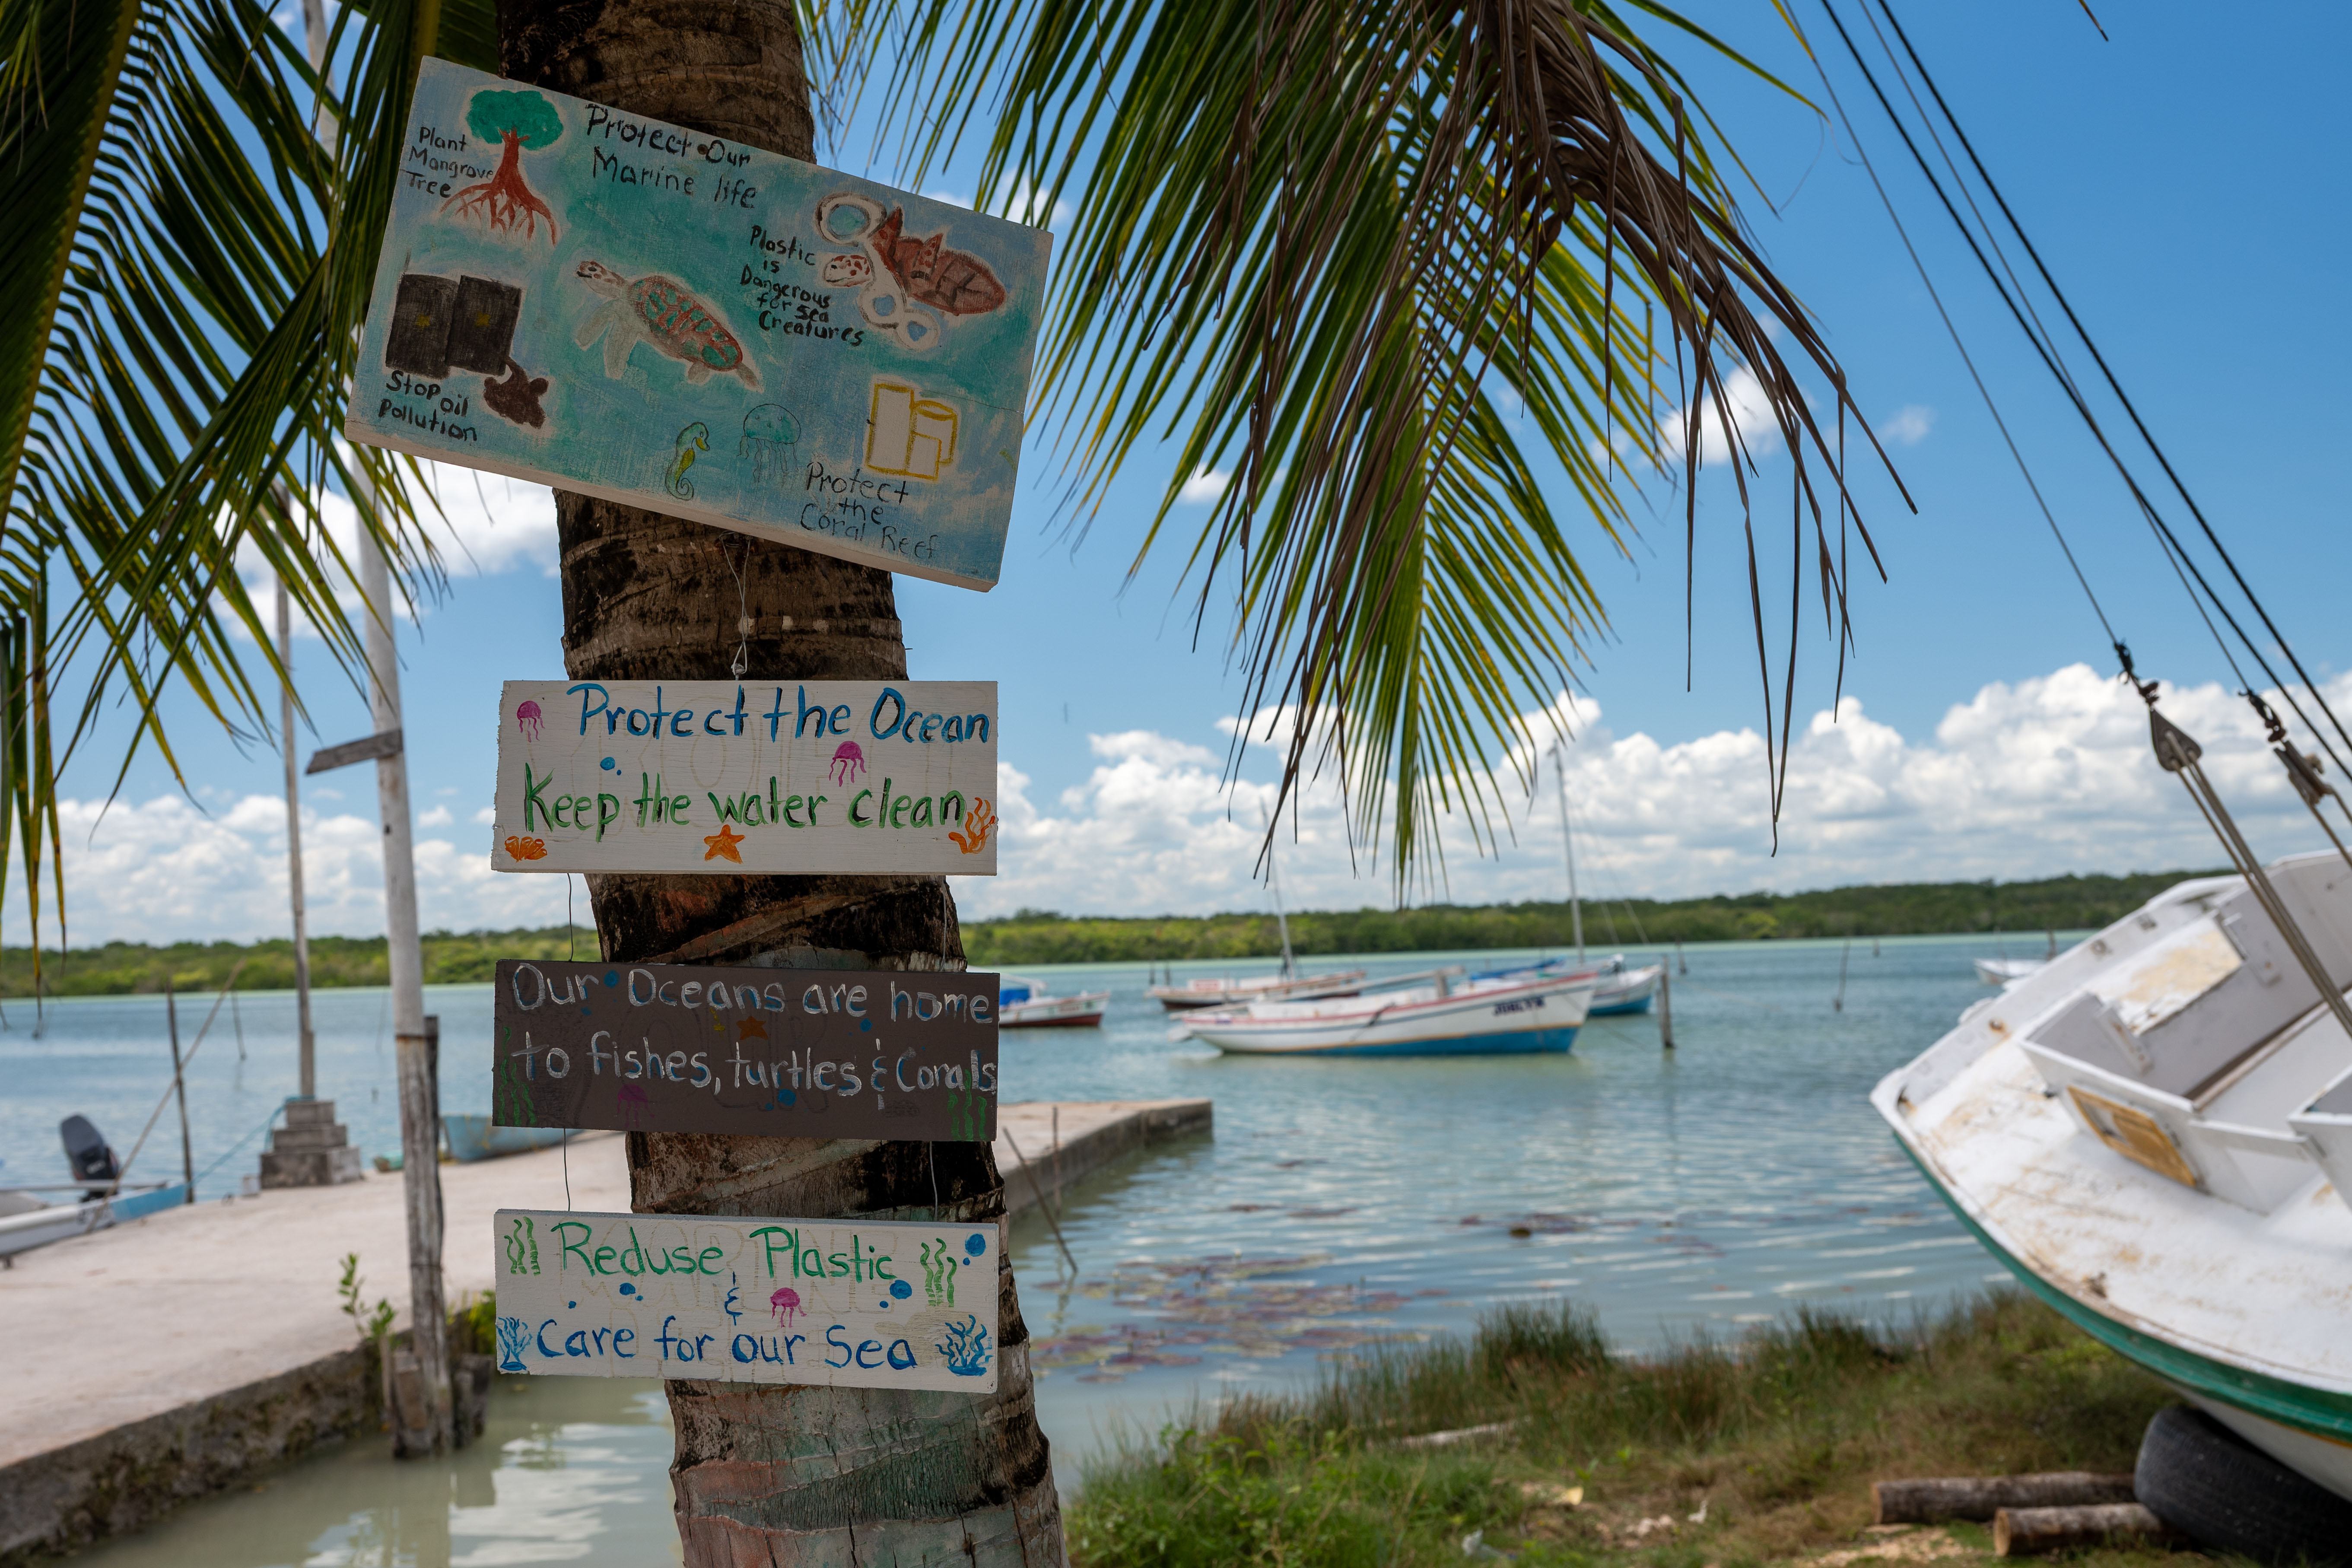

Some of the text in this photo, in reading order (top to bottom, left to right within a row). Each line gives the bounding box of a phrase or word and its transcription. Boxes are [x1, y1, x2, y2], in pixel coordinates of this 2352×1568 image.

[419, 127, 467, 152] Plant
[585, 104, 750, 168] Protect Our
[409, 146, 493, 178] Mangrove
[593, 146, 757, 208] Marine life
[406, 171, 451, 198] Tree
[750, 225, 815, 265] Plastic
[763, 256, 779, 273] is
[740, 264, 831, 309] Dangerous
[757, 292, 792, 311] for
[759, 310, 864, 347] Creatures
[386, 369, 441, 400] Stop
[378, 398, 477, 442] Pollution
[807, 461, 909, 505] Protect
[800, 503, 938, 559] Coral Reef
[839, 497, 884, 525] the
[566, 683, 991, 743] Protect the Ocean
[524, 763, 966, 844] Keep the water clean
[512, 962, 993, 1024] Our Oceans are home
[510, 1031, 570, 1081] to
[586, 1030, 721, 1095] fishes,
[725, 1040, 862, 1096] turtles
[896, 1046, 997, 1095] Corals
[550, 1221, 897, 1283] Reduse Plastic
[537, 1315, 918, 1370] Care for our Sea
